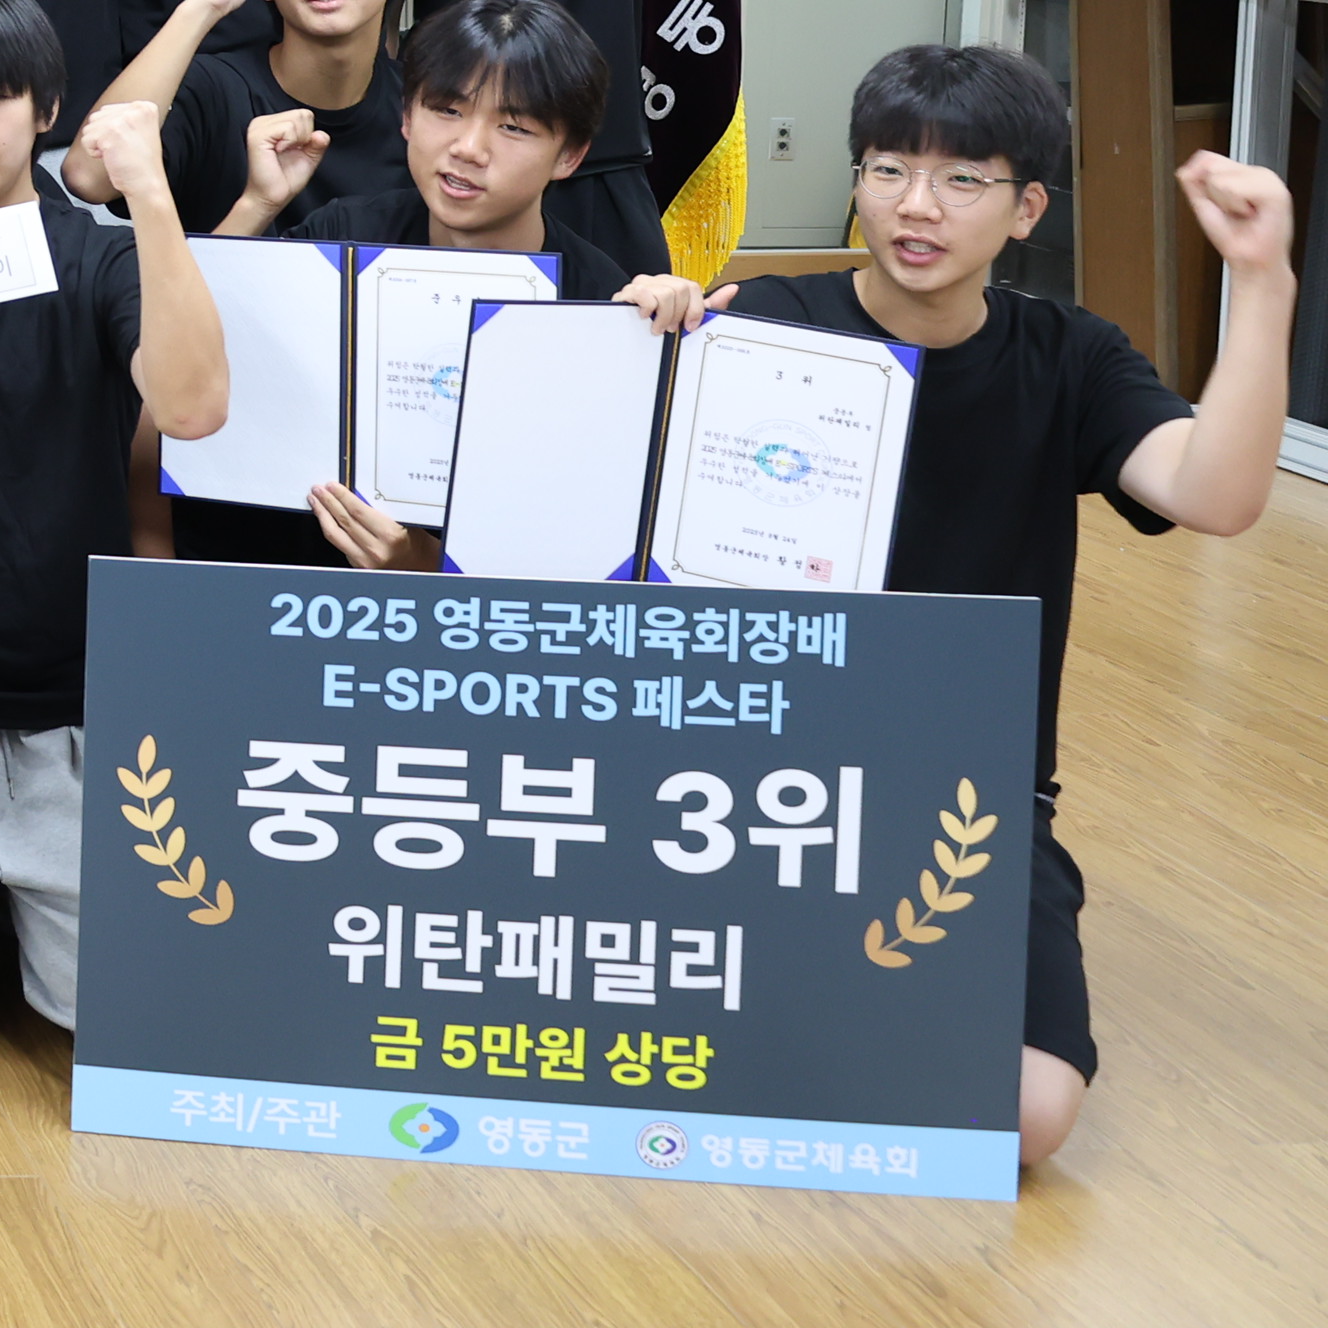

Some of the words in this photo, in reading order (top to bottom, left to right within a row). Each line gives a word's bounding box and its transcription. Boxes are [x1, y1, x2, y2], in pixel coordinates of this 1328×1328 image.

[271, 593, 417, 642] 2025
[439, 596, 846, 667] 영동군체육회장배
[324, 665, 617, 721] E-SPORTS
[632, 676, 789, 734] 페스타
[238, 741, 606, 877] 중등부
[653, 767, 862, 893] 3위
[329, 905, 742, 1010] 위탄패밀리
[371, 1017, 422, 1069] 금
[442, 1024, 585, 1081] 5만원
[605, 1032, 714, 1089] 상당
[170, 1089, 341, 1140] 주최/주관
[478, 1116, 589, 1159] 영동군
[701, 1134, 918, 1178] 영동군체육회
